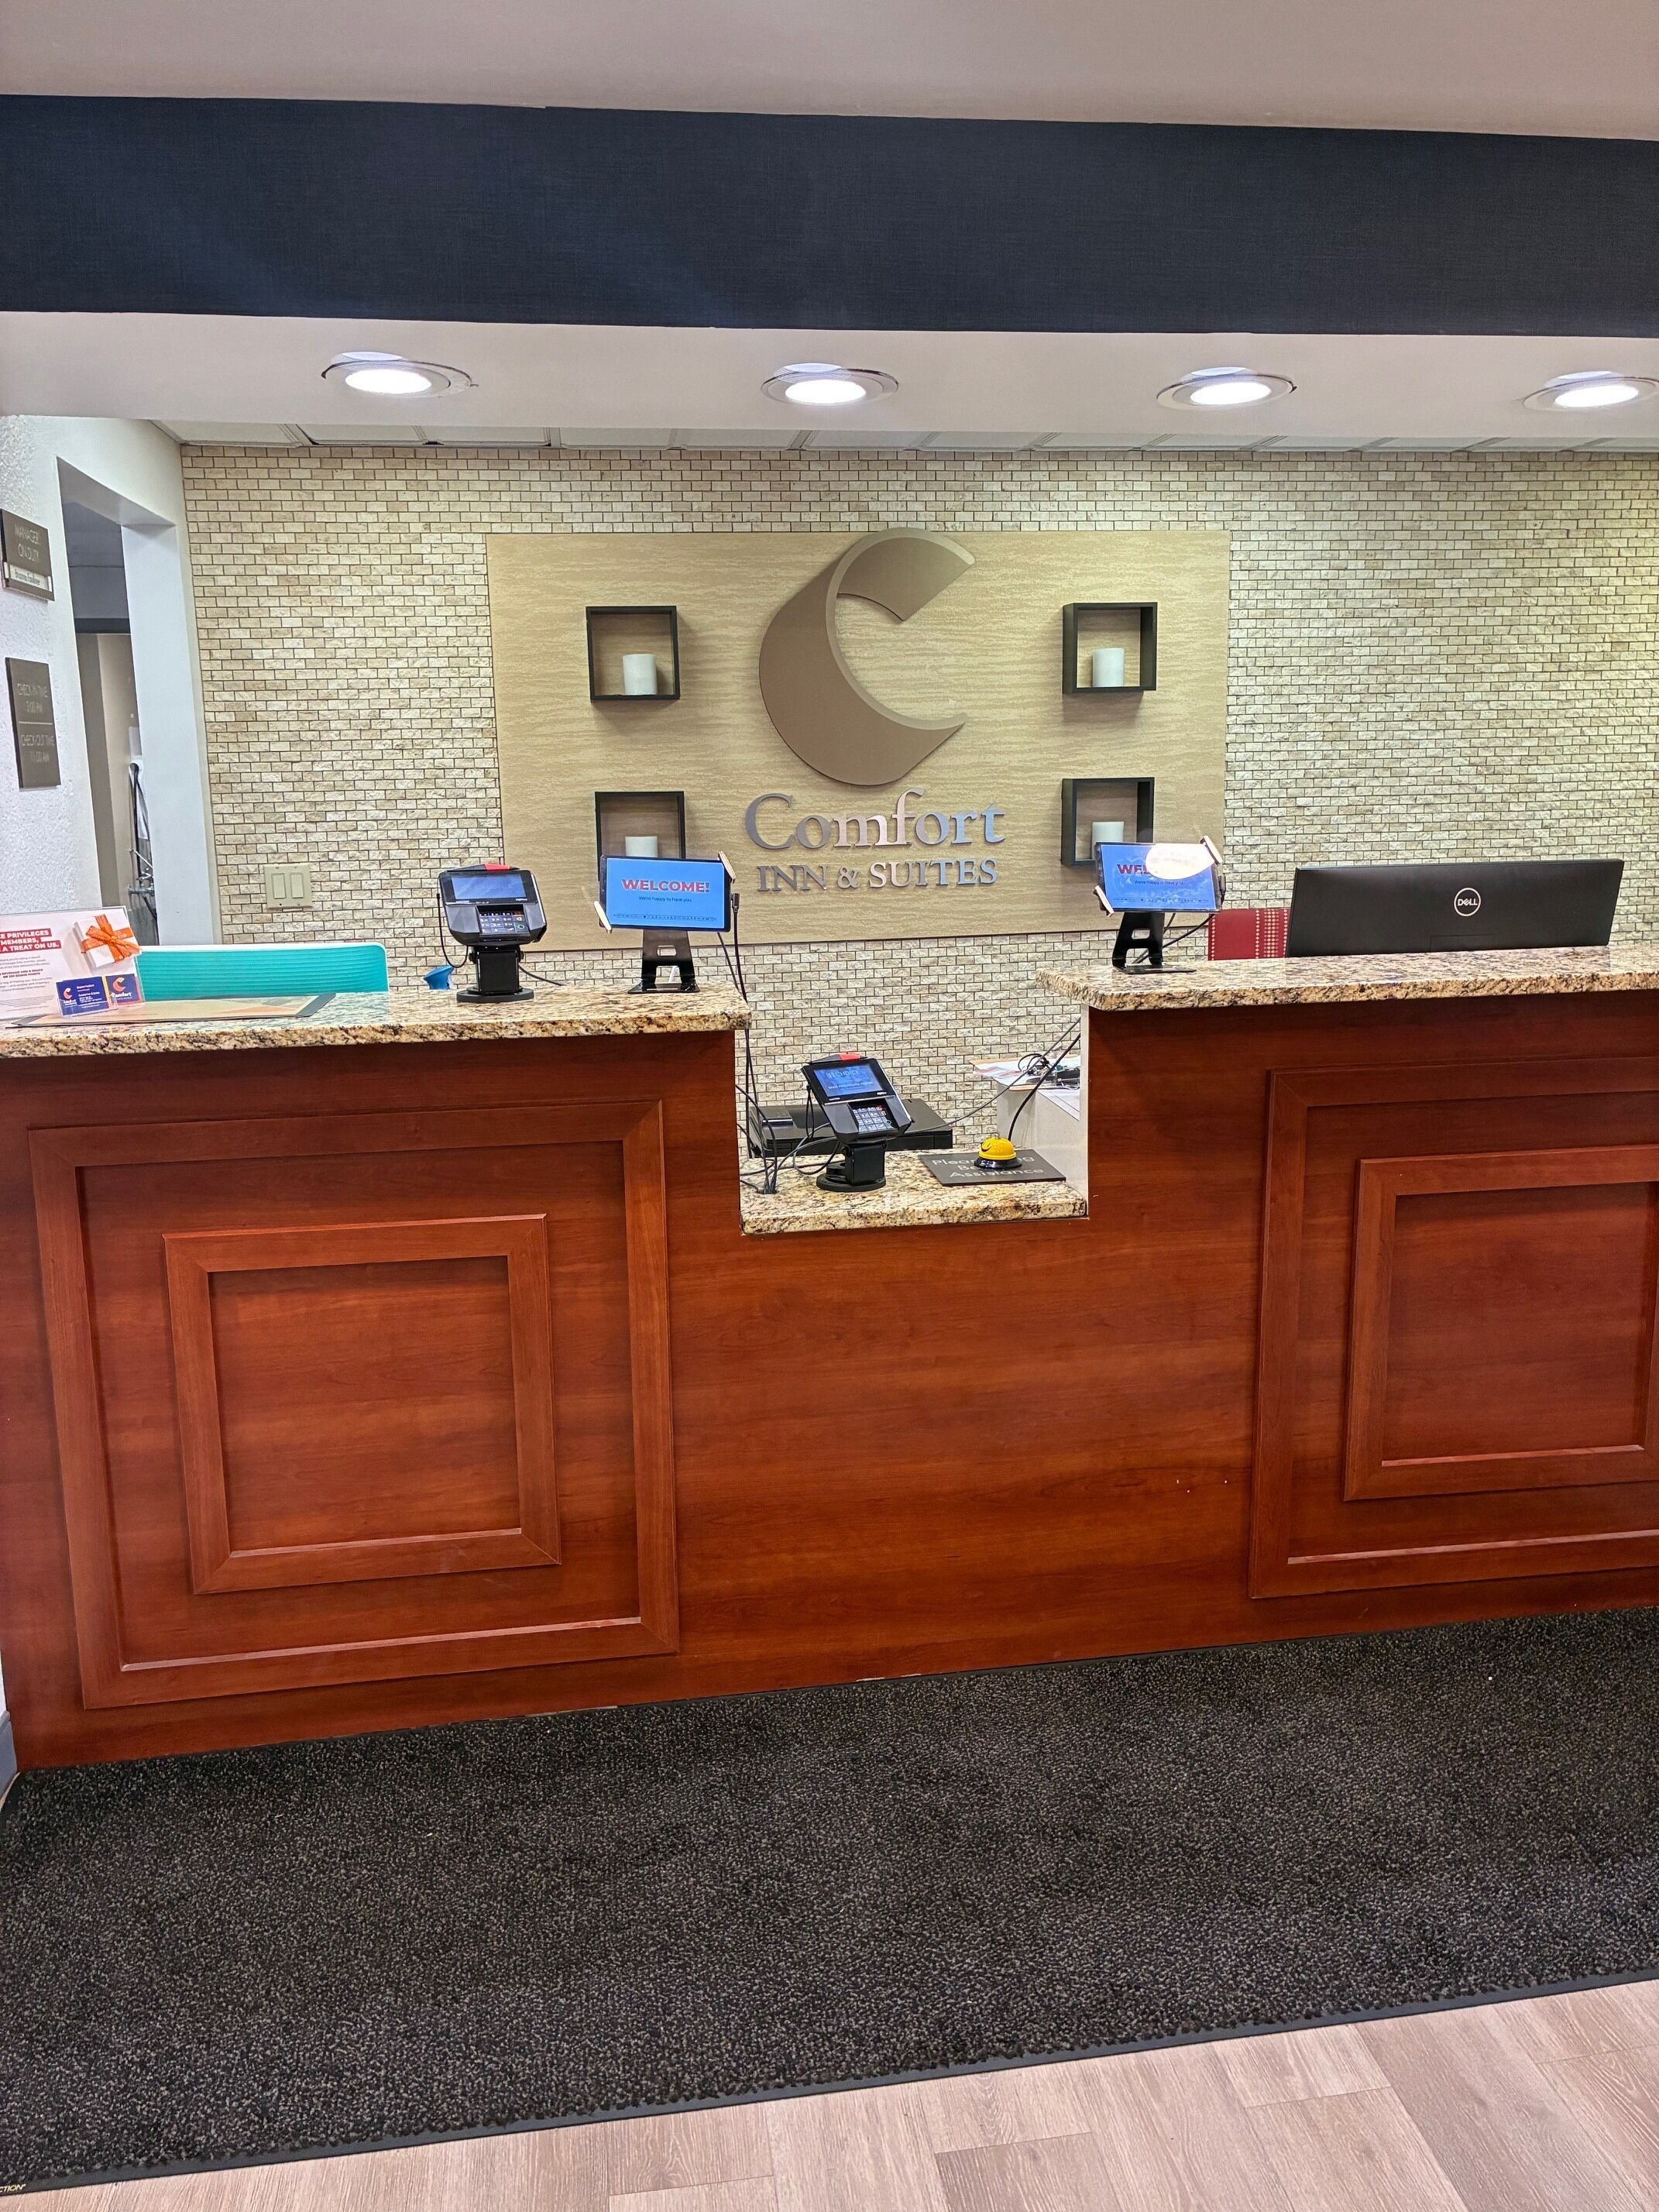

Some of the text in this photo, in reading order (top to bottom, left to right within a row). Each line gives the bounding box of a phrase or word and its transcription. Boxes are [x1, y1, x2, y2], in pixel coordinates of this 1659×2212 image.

[745, 787, 1007, 850] Comfort
[756, 858, 998, 892] INN & SUITES
[622, 878, 709, 892] WELCOME!
[7, 930, 50, 939] PRIVILEGES
[0, 937, 40, 946] MEMBERS,
[950, 1169, 1044, 1177] Assistance
